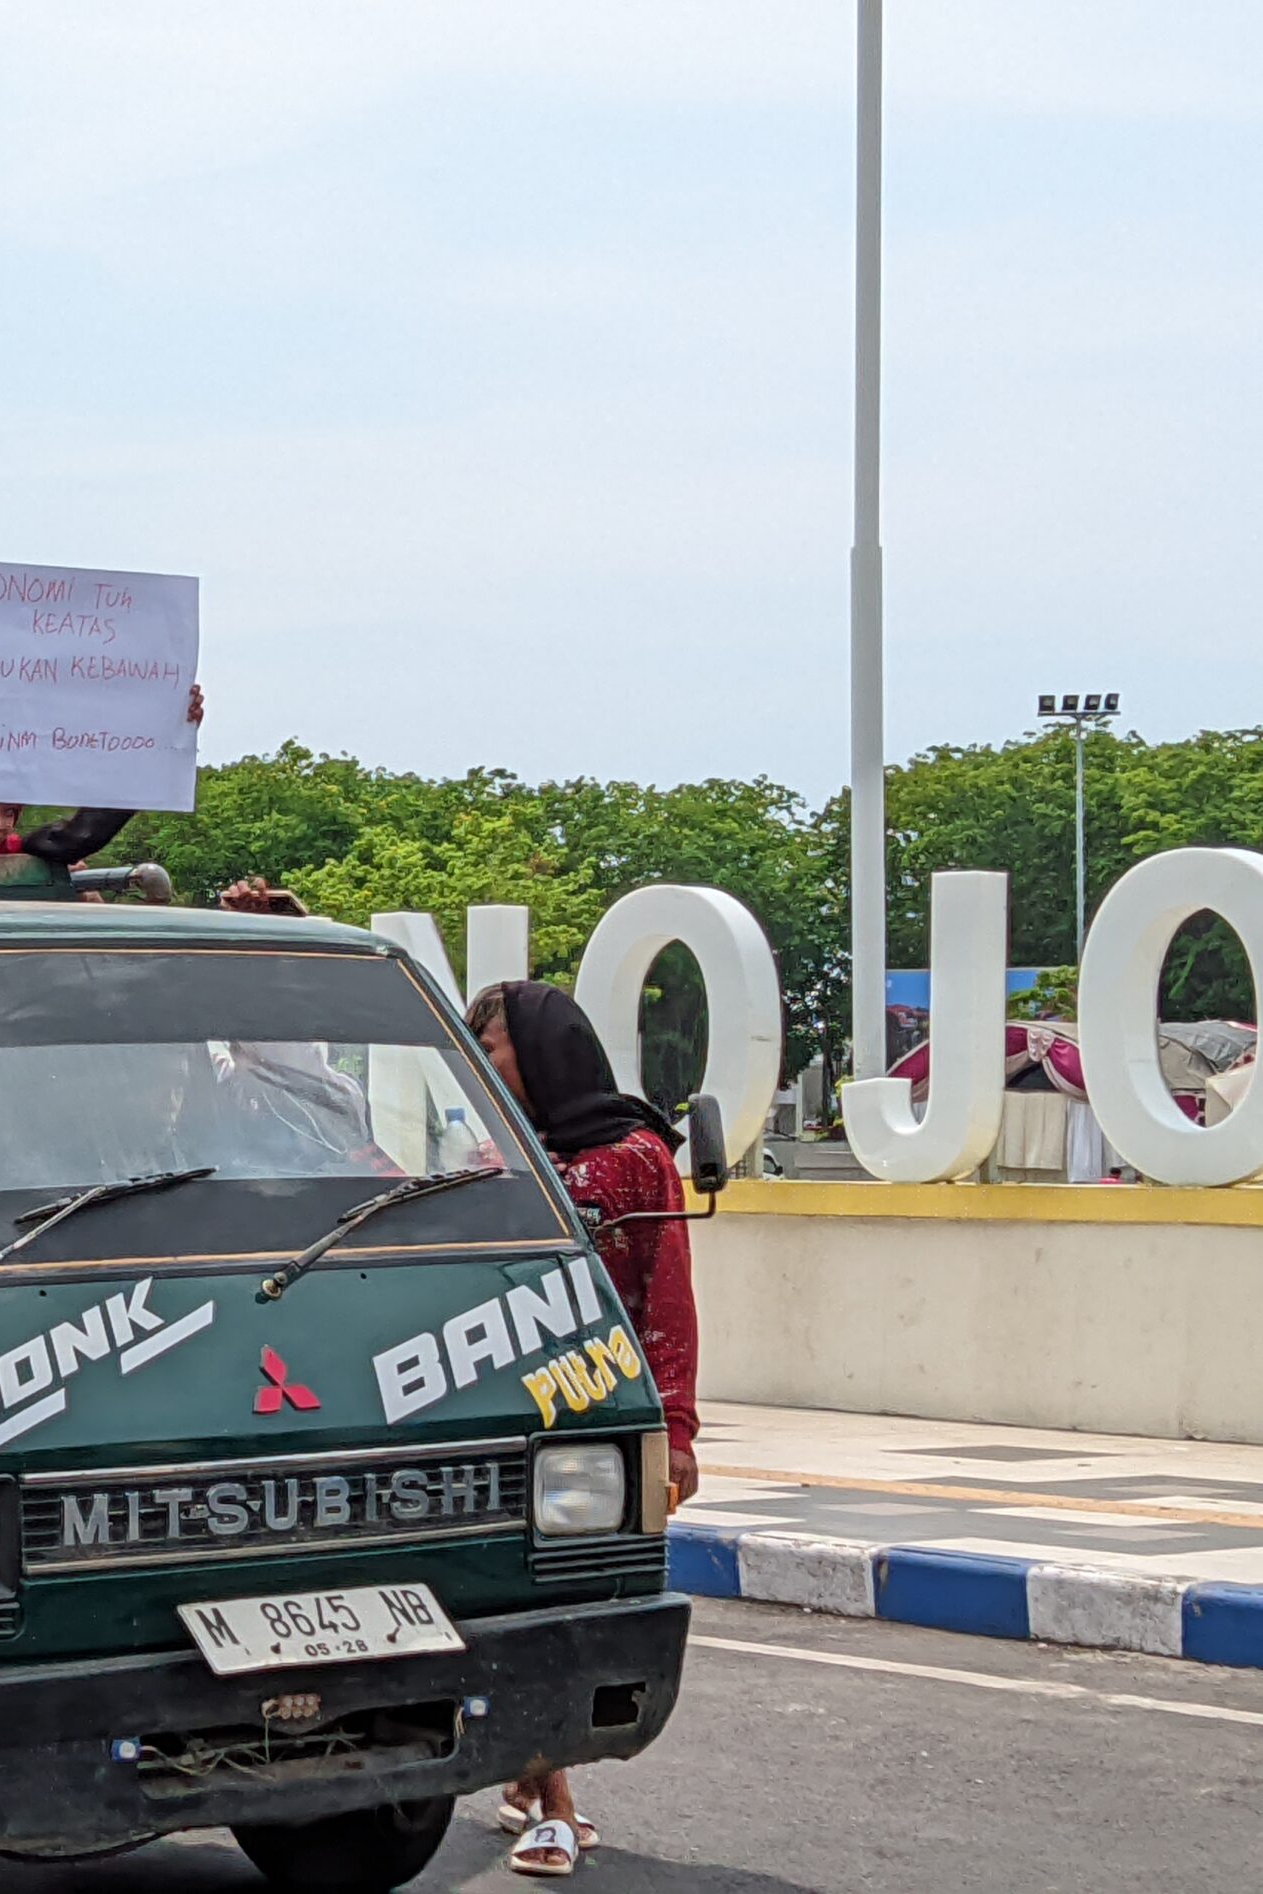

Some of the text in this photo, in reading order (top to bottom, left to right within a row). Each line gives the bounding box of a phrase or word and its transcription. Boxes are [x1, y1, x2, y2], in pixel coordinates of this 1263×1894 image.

[32, 611, 116, 644] KEATAS
[70, 655, 181, 688] KEBAWAH
[373, 1257, 604, 1425] BANI
[60, 1462, 501, 1546] MITSUBISHI
[195, 1589, 434, 1648] M 8645 NB
